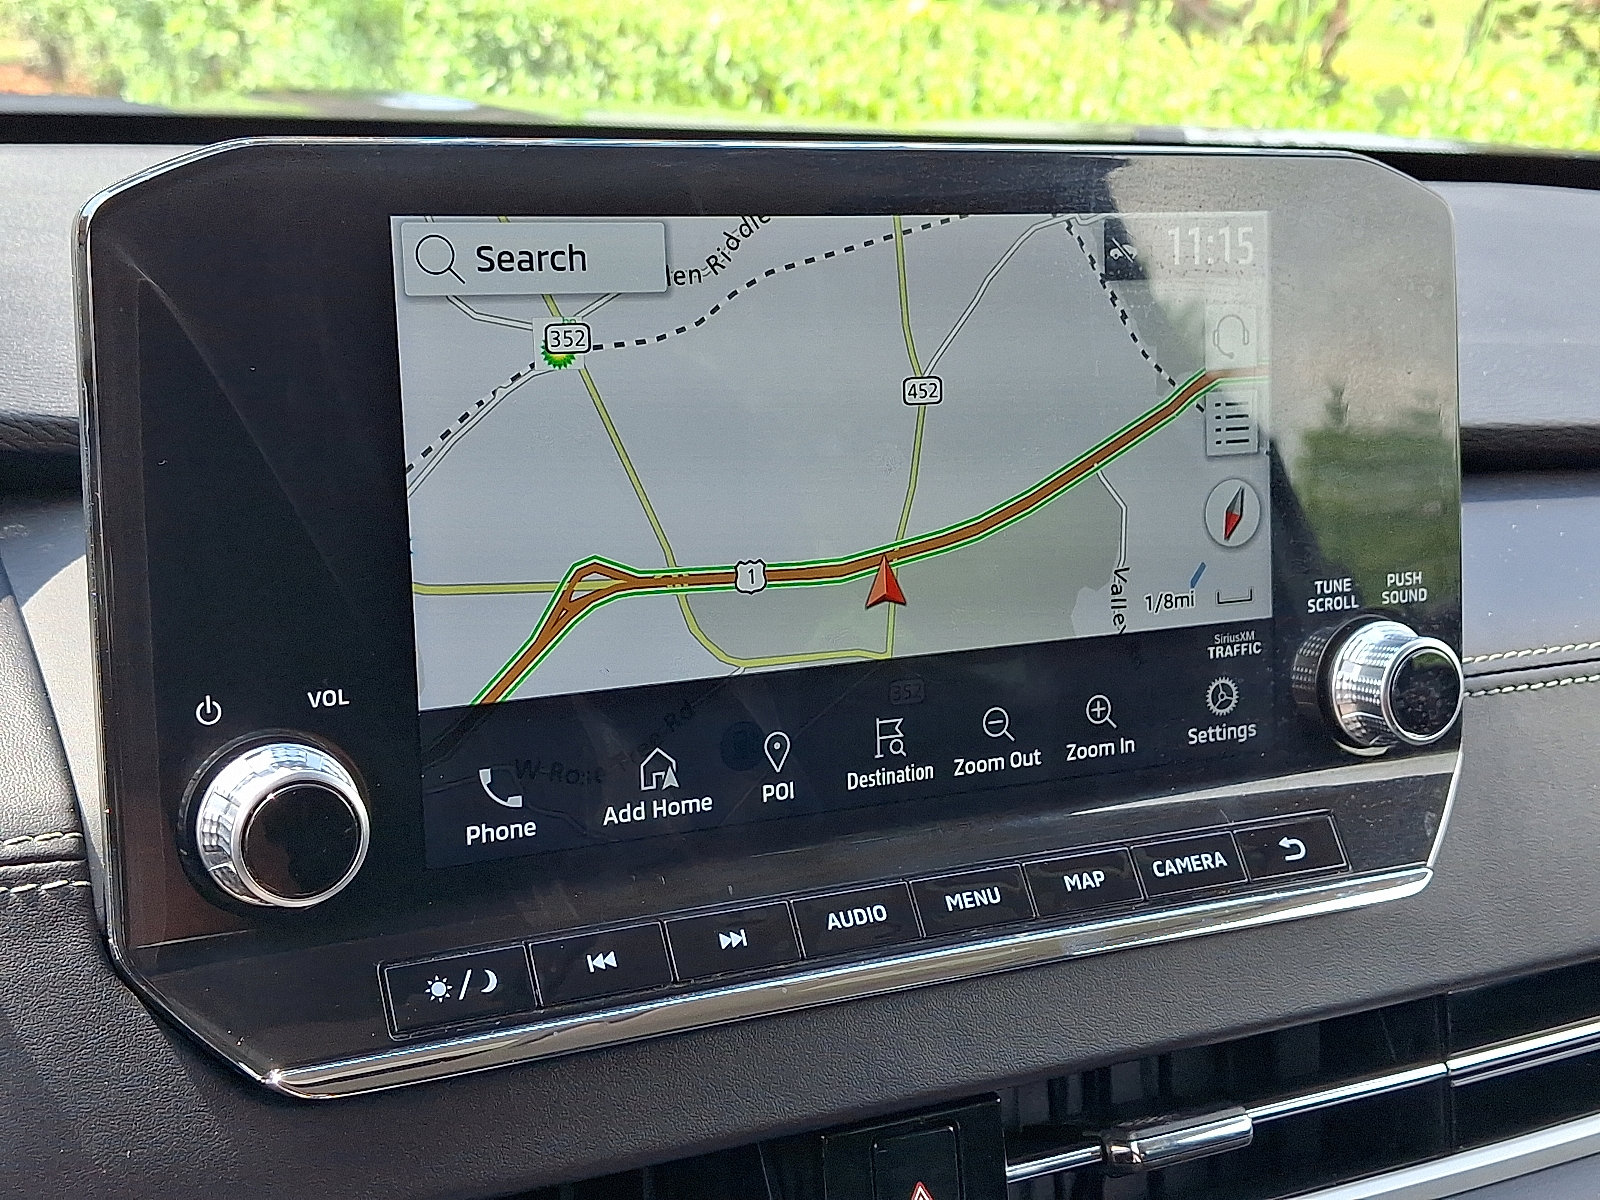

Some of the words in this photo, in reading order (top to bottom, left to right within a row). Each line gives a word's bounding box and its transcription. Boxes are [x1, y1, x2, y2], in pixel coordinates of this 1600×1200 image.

[1168, 226, 1254, 266] 11:15
[476, 243, 587, 273] Search
[550, 329, 586, 348] 352
[907, 382, 938, 399] 452
[1314, 577, 1352, 595] TUNE
[1386, 571, 1423, 588] PUSH
[1145, 590, 1195, 614] 1/8mi
[1307, 594, 1360, 613] SCROLL
[1382, 588, 1427, 604] SOUND
[1214, 630, 1256, 645] SiriusXM
[1208, 642, 1262, 660] TRAFFIC
[307, 688, 350, 708] VOL
[1187, 723, 1257, 745] Settings
[1066, 742, 1115, 762] Zoom
[1120, 737, 1135, 754] In
[953, 756, 1005, 777] Zoom
[1009, 748, 1042, 769] Out
[847, 763, 934, 791] Destination
[762, 781, 795, 803] POI
[602, 800, 646, 826] Add
[652, 796, 713, 819] Home
[466, 821, 537, 846] Phone
[1152, 851, 1228, 878] CAMERA
[1063, 870, 1105, 892] MAP
[944, 886, 1001, 912] MENU
[827, 904, 887, 931] AUDIO
